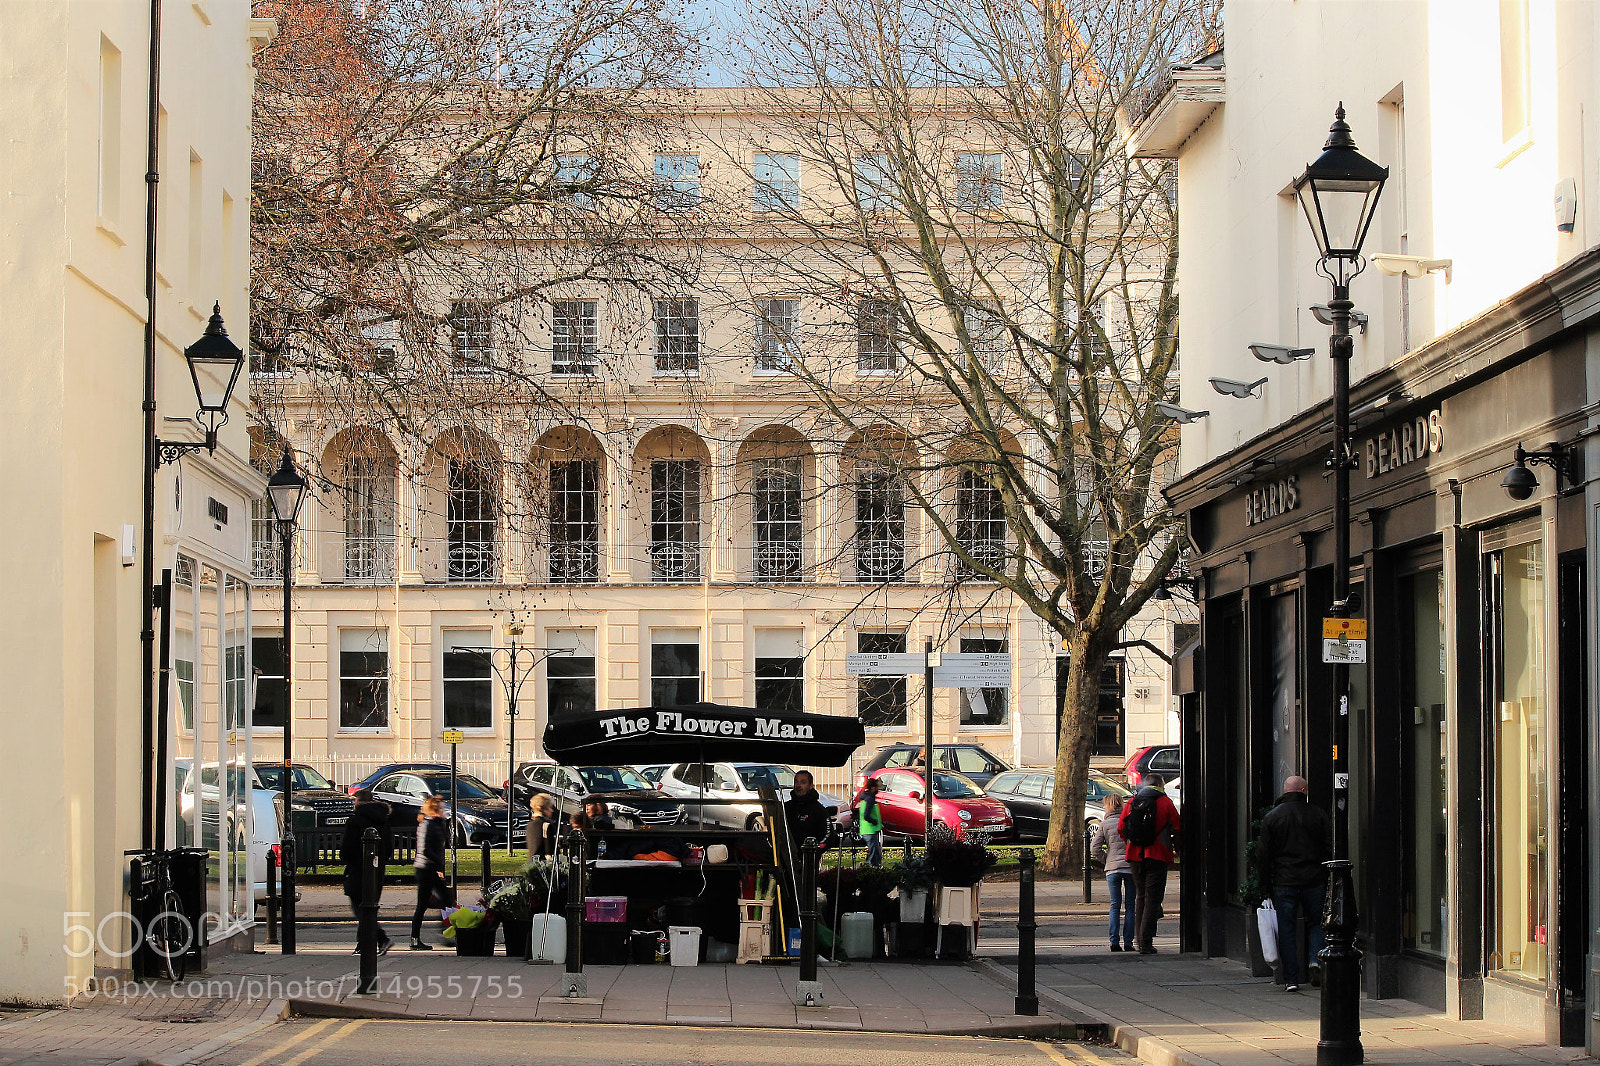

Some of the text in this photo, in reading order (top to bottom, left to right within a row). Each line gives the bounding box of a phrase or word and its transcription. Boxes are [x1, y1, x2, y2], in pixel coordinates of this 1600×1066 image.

[1367, 409, 1444, 479] BEARDS
[1245, 475, 1298, 527] BEARDS
[600, 711, 815, 739] The Flower Man
